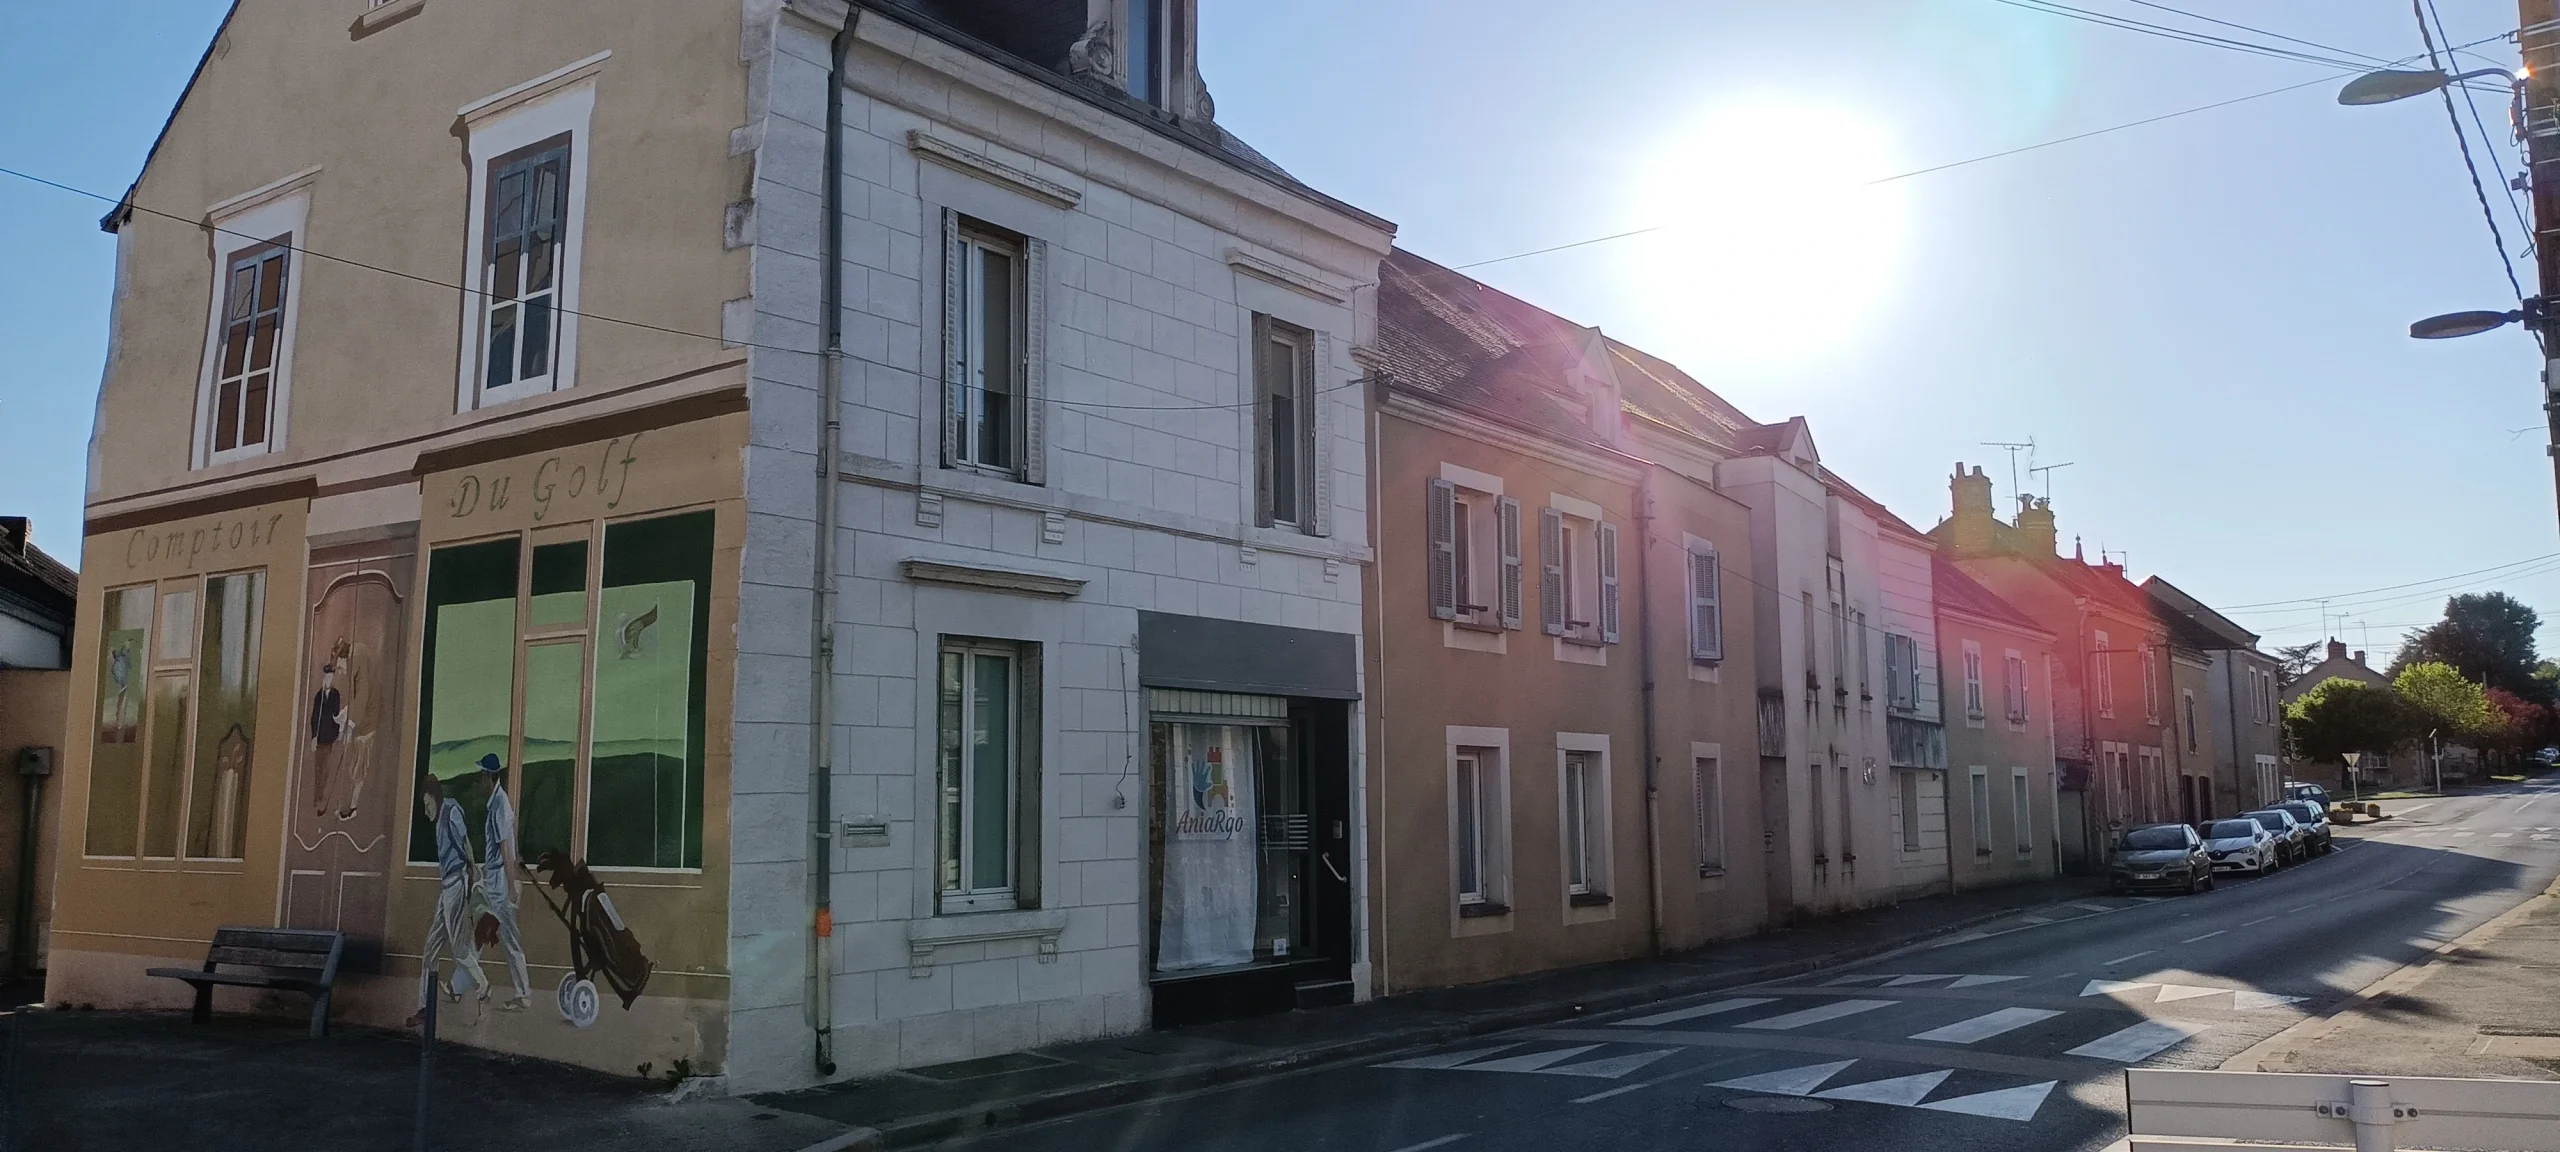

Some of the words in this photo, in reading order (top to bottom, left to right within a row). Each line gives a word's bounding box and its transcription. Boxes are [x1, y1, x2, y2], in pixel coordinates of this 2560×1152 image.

[450, 475, 511, 518] Du
[533, 432, 644, 521] Golf
[126, 507, 283, 570] Comptoir
[1175, 809, 1244, 840] AniaRgo
